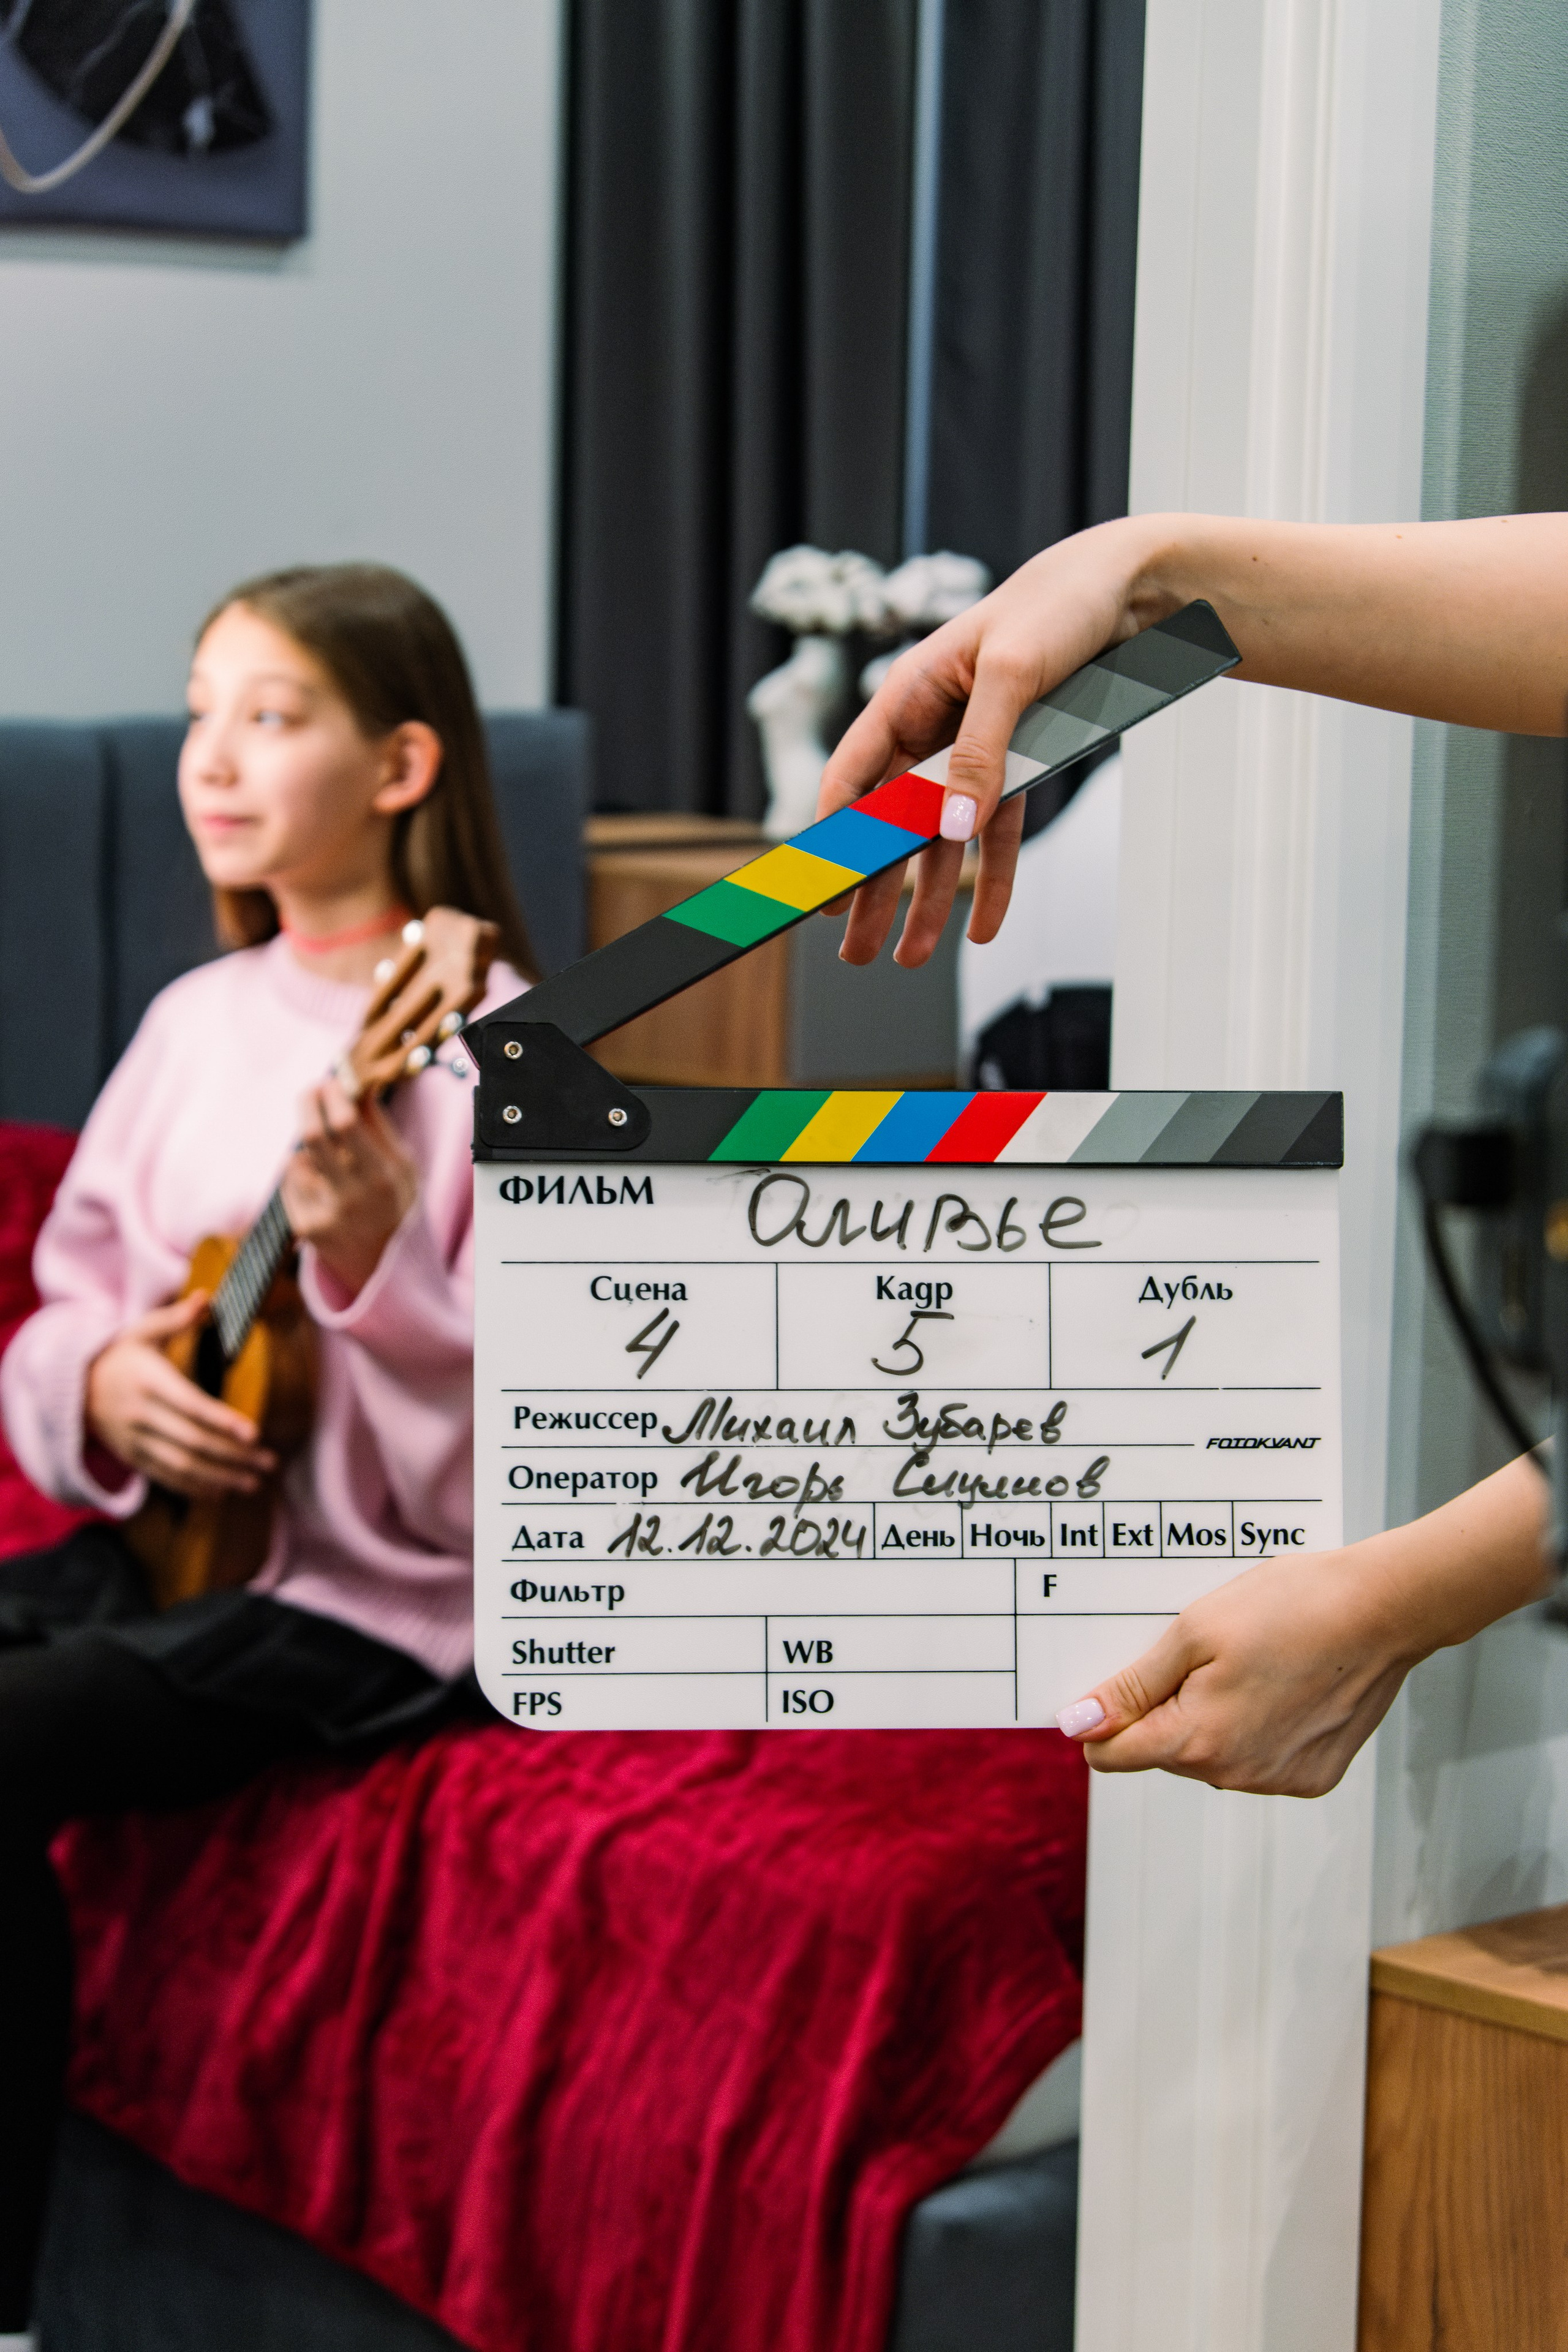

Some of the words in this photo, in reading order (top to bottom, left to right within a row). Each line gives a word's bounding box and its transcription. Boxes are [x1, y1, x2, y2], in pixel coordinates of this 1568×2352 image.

[498, 1174, 655, 1205] ФИЛЬМ
[747, 1172, 1102, 1252] Оливье
[589, 1275, 689, 1303] Сцена
[876, 1275, 954, 1310] Кадр
[1137, 1274, 1234, 1310] Дубль
[624, 1306, 680, 1381] 4
[870, 1310, 956, 1377] 5
[1140, 1315, 1197, 1381] 1
[514, 1405, 658, 1439] Режиссер
[661, 1395, 857, 1446] Михаил
[882, 1390, 1068, 1455] Зубарев
[1205, 1436, 1322, 1450] FOTOKVANT
[507, 1464, 658, 1498] Оператор
[680, 1450, 843, 1519] Игорь
[511, 1525, 586, 1552] Дата
[606, 1512, 866, 1558] 12.12.2024
[880, 1523, 956, 1551] День
[970, 1523, 1046, 1548] Ночь
[1060, 1522, 1099, 1547] Int
[1112, 1522, 1155, 1547] Ext
[1166, 1522, 1227, 1547] Mos
[1240, 1521, 1306, 1555] Sync
[510, 1578, 625, 1611] Фильтр
[1042, 1573, 1058, 1598] F
[511, 1637, 616, 1665] Shutter
[782, 1639, 834, 1665] WB
[513, 1691, 563, 1717] FPS
[782, 1689, 835, 1714] ISO
